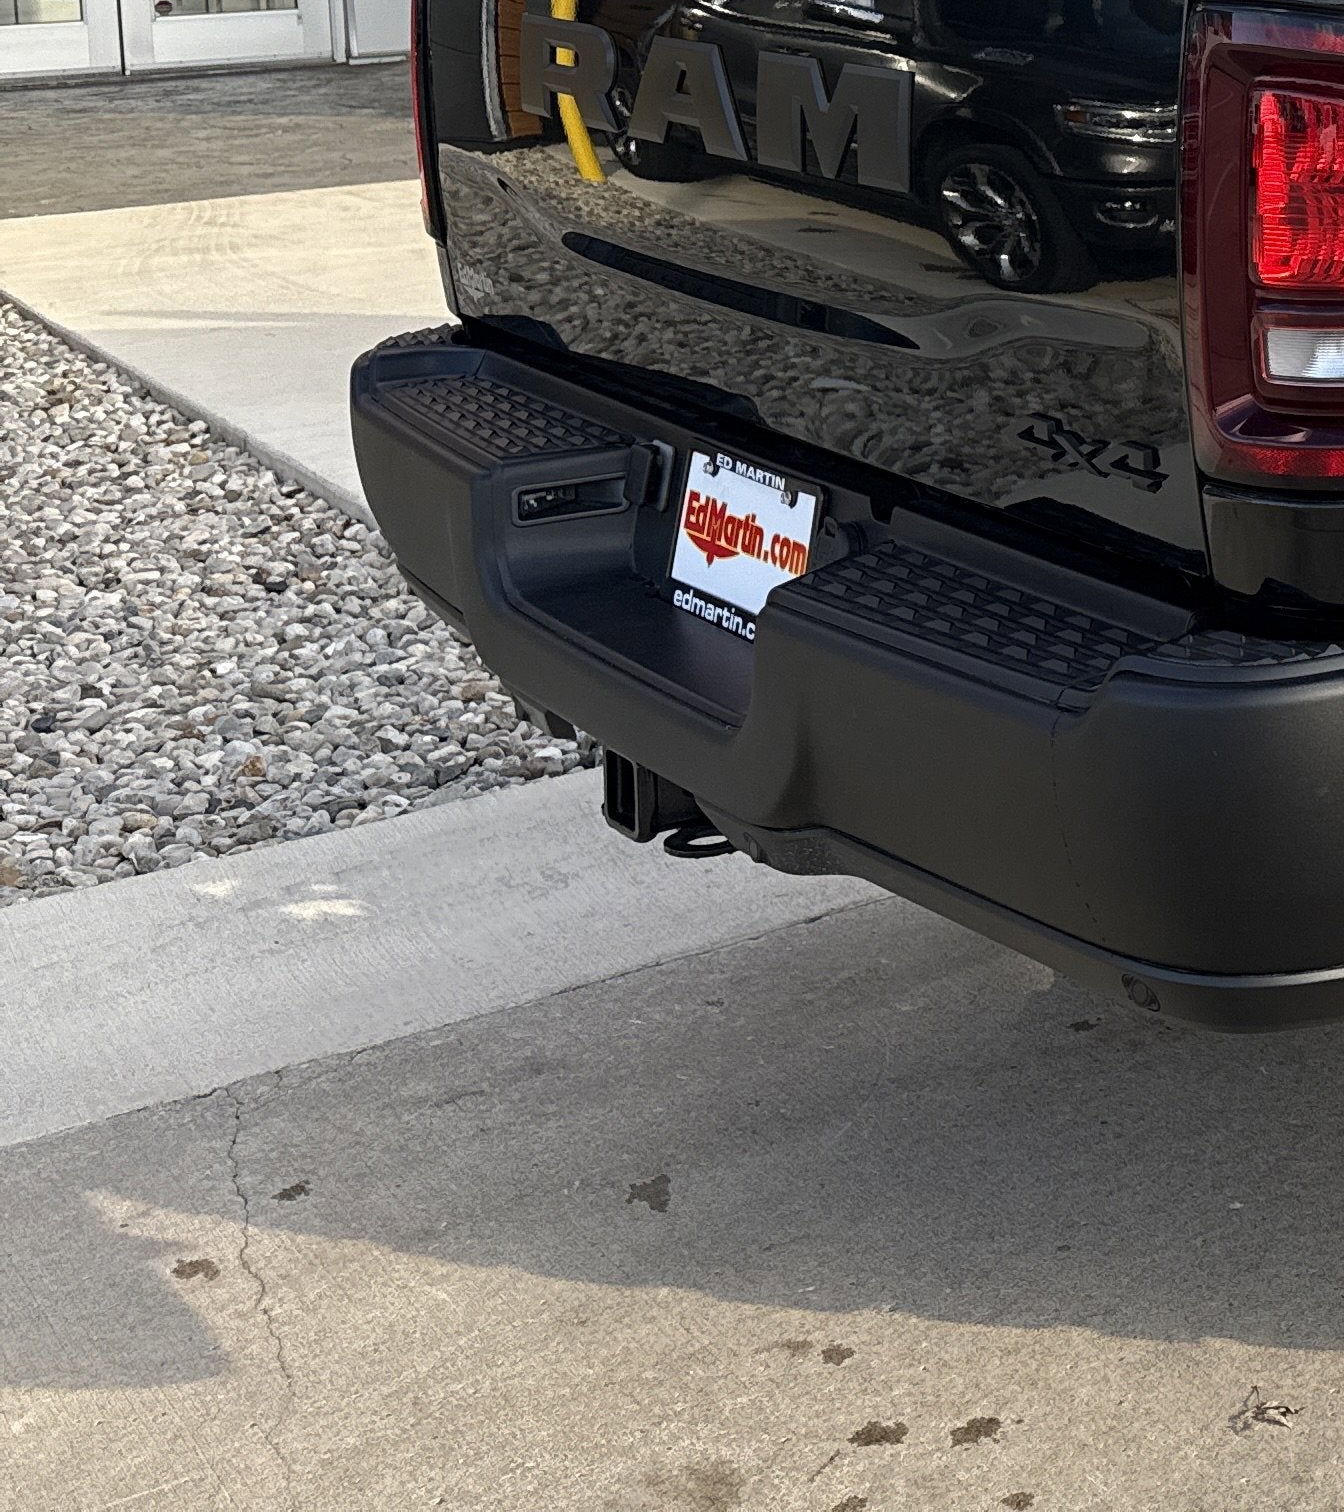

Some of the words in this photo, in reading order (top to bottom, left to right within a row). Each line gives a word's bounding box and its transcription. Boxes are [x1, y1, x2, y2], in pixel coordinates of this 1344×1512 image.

[519, 13, 917, 192] RAM
[716, 452, 733, 469] ED
[735, 461, 786, 491] MARTIN
